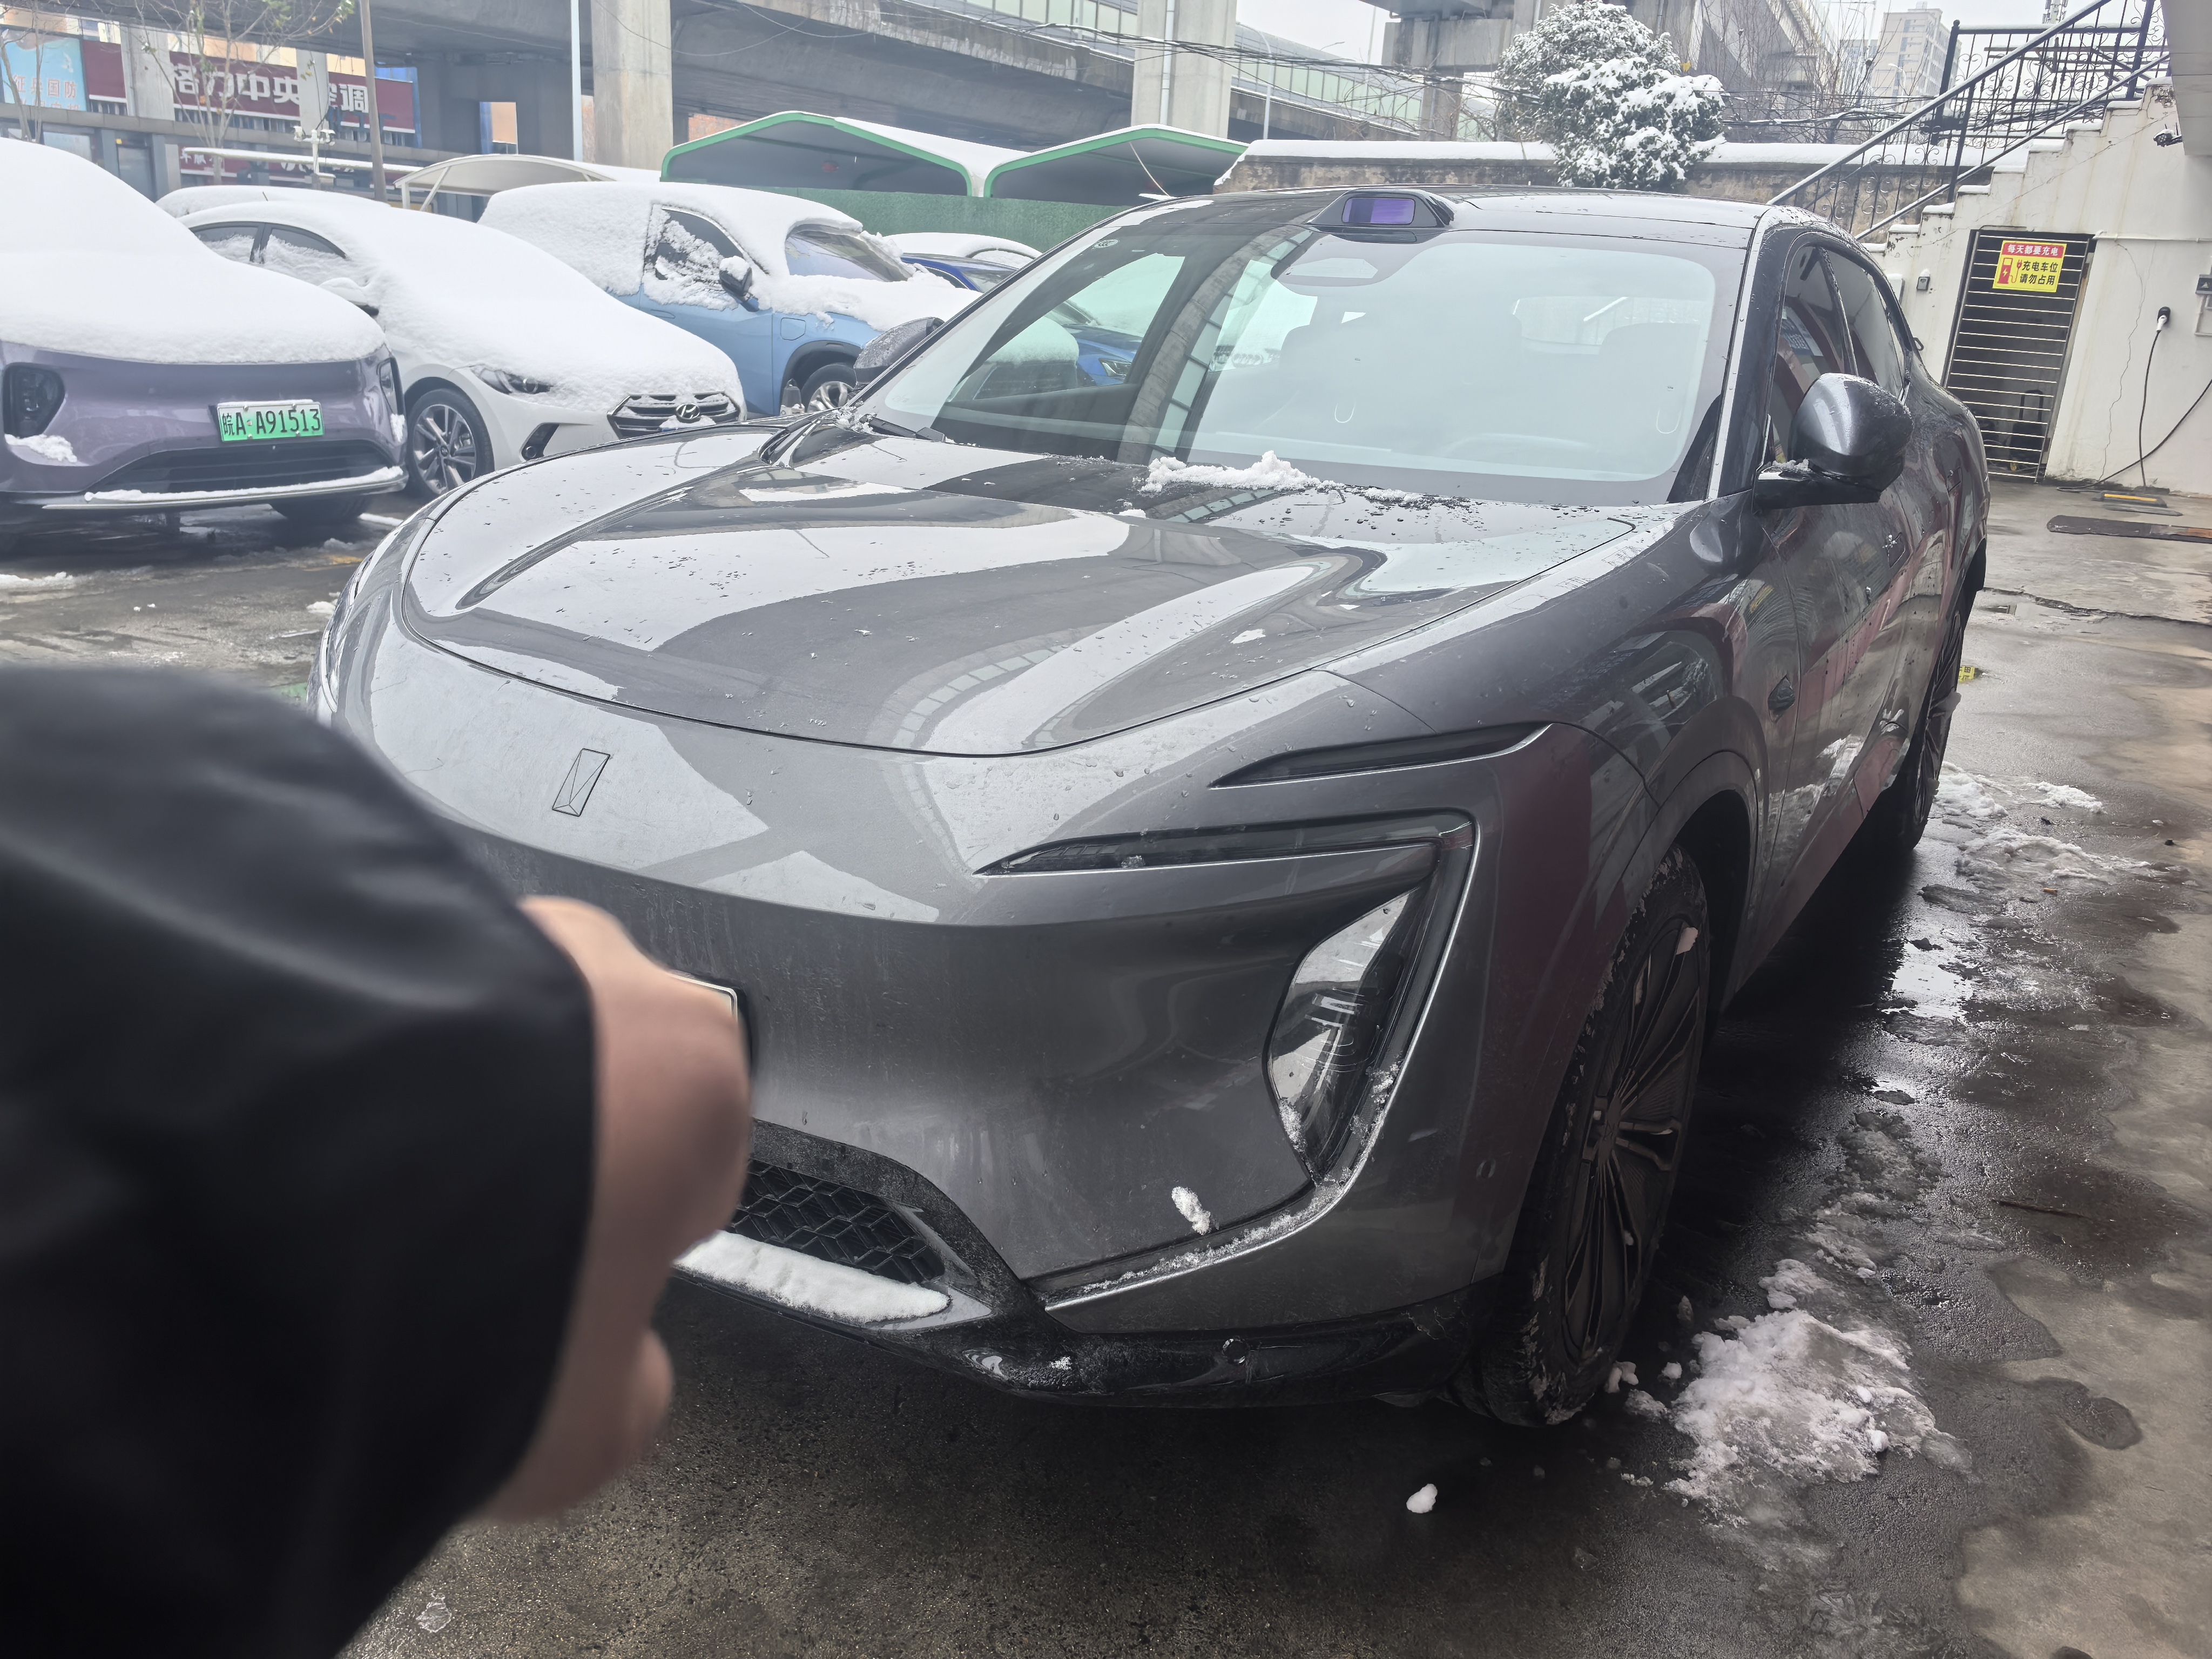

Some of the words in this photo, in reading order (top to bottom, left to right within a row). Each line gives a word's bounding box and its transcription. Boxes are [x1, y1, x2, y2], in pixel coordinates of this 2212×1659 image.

[2008, 244, 2059, 256] 每天都要充电
[2022, 261, 2058, 273] 充电车位
[2020, 274, 2055, 286] 请勿占用
